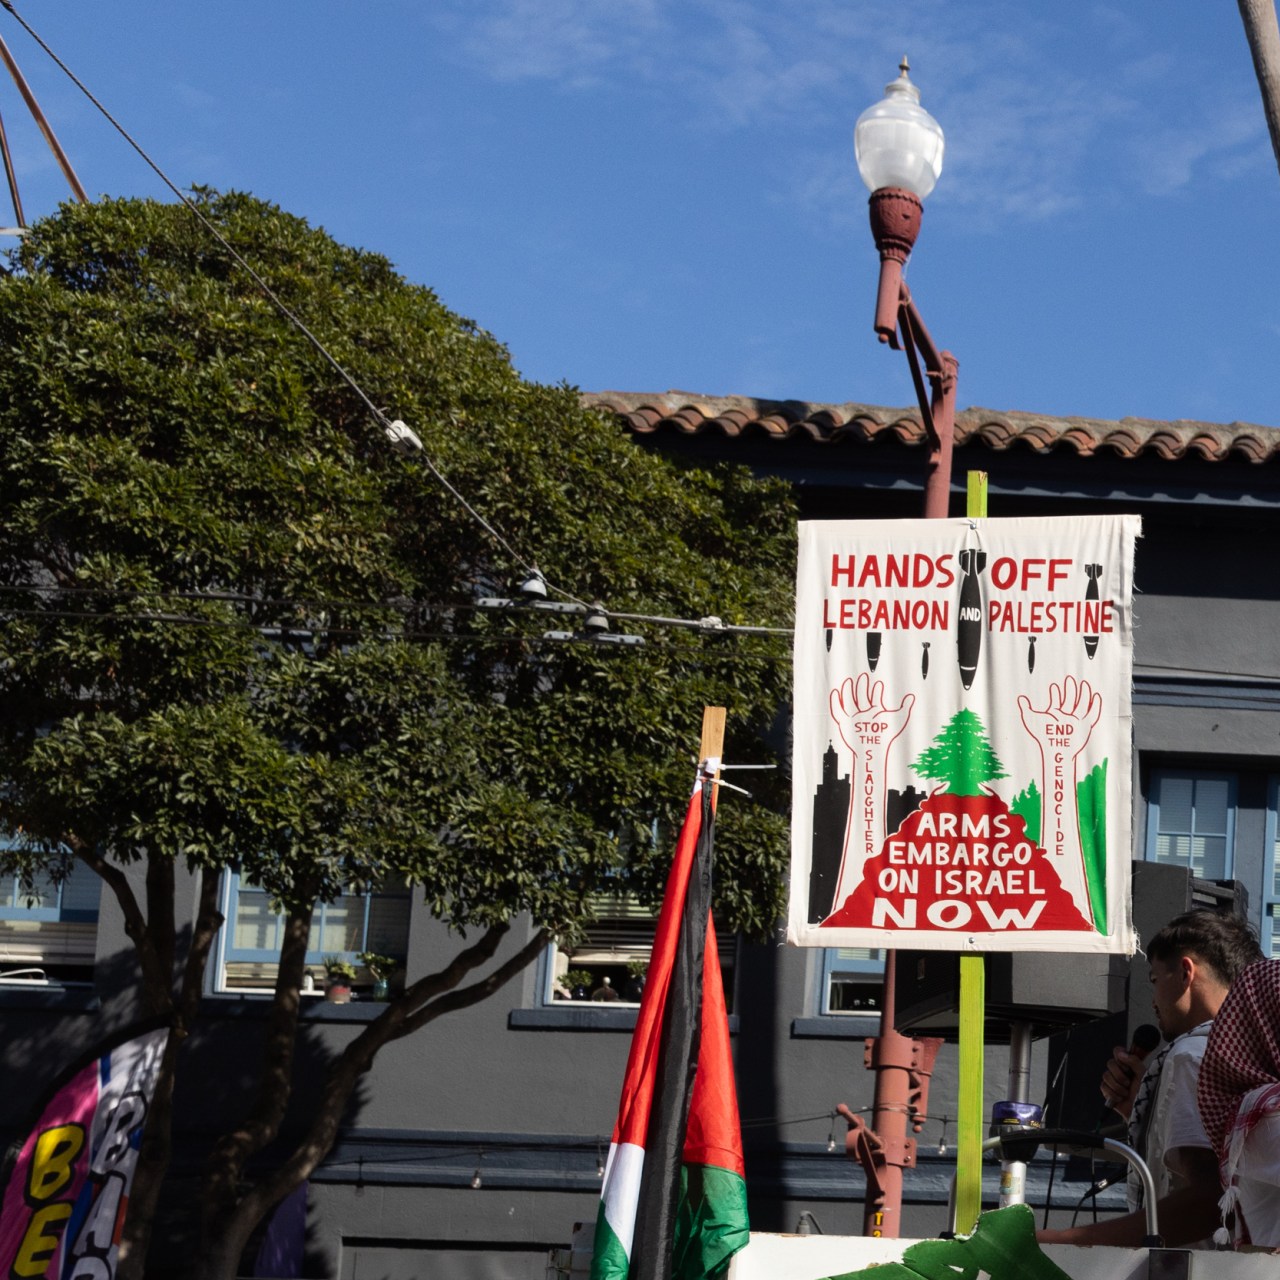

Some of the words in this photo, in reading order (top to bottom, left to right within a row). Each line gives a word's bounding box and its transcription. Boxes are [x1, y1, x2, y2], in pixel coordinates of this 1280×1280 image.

[831, 553, 955, 588] HANDS
[991, 557, 1073, 592] OFF
[823, 599, 949, 631] LEBANON
[959, 606, 981, 622] AND
[988, 600, 1114, 633] PALESTINE
[855, 722, 888, 734] STOP
[859, 735, 881, 745] THE
[1045, 723, 1074, 736] END
[1048, 737, 1071, 748] THE
[864, 750, 875, 854] SLAUGHTER
[1053, 752, 1064, 857] GENOCIDE
[916, 812, 1011, 838] ARMS
[888, 841, 1032, 866] EMBARGO
[878, 868, 918, 895] ON
[935, 869, 1045, 895] ISRAEL
[872, 898, 1047, 930] NOW
